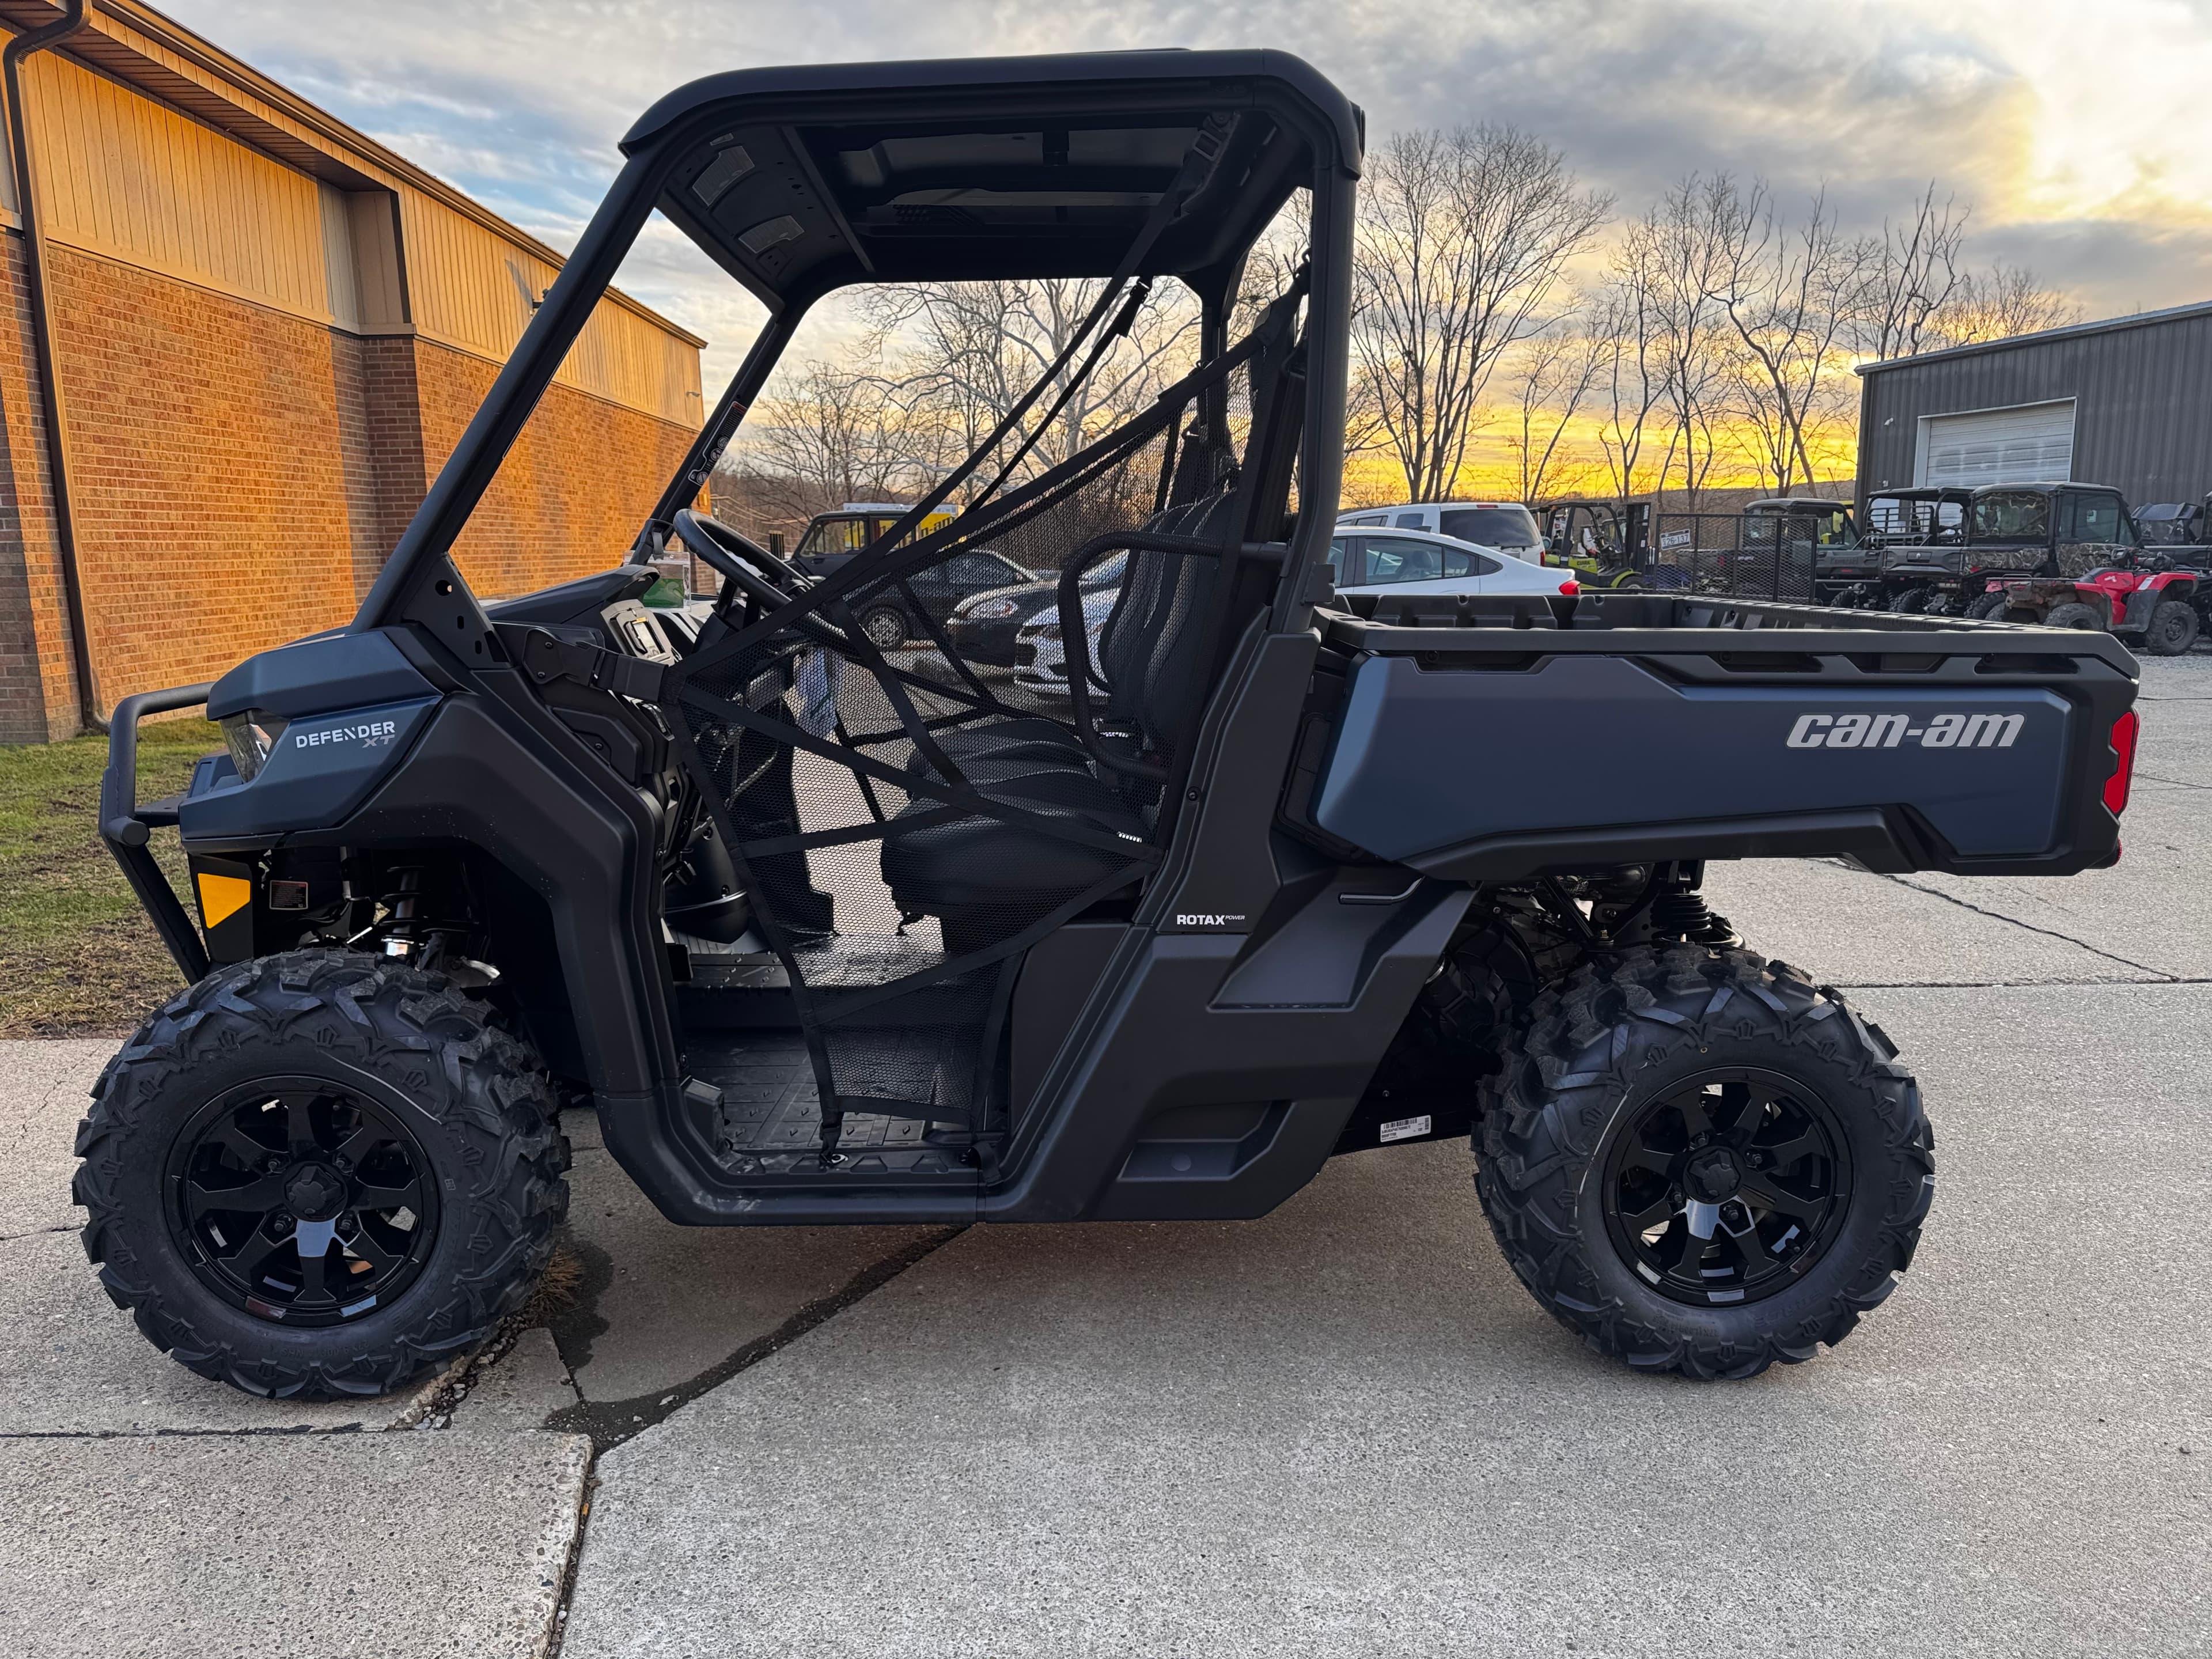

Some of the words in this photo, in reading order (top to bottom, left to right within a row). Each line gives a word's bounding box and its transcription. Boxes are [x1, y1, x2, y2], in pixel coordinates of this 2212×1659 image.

[296, 721, 395, 748] DEFENDER
[362, 734, 395, 748] XT
[1786, 714, 2025, 748] can-am
[1177, 915, 1225, 925] ROTAX
